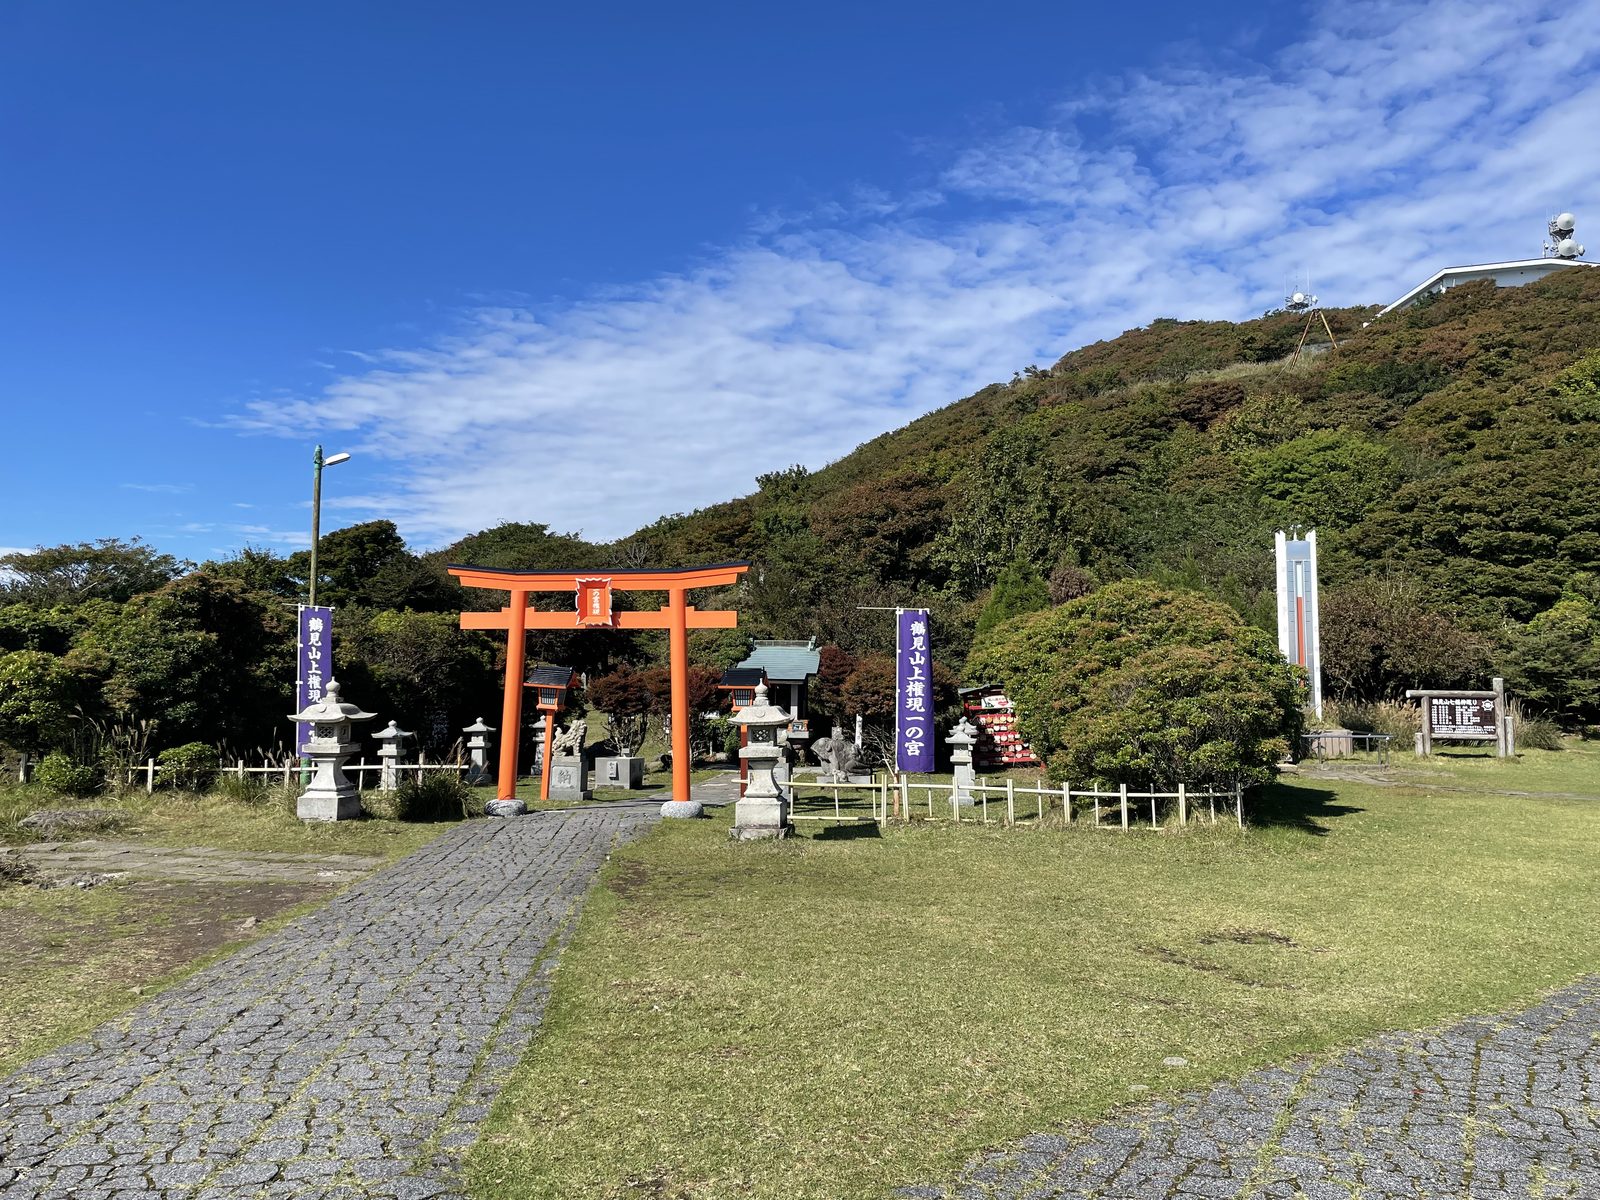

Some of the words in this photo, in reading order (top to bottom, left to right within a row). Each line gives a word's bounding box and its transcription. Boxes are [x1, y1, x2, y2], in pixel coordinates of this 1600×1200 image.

[904, 621, 926, 757] 鶴見山上権現一の宮
